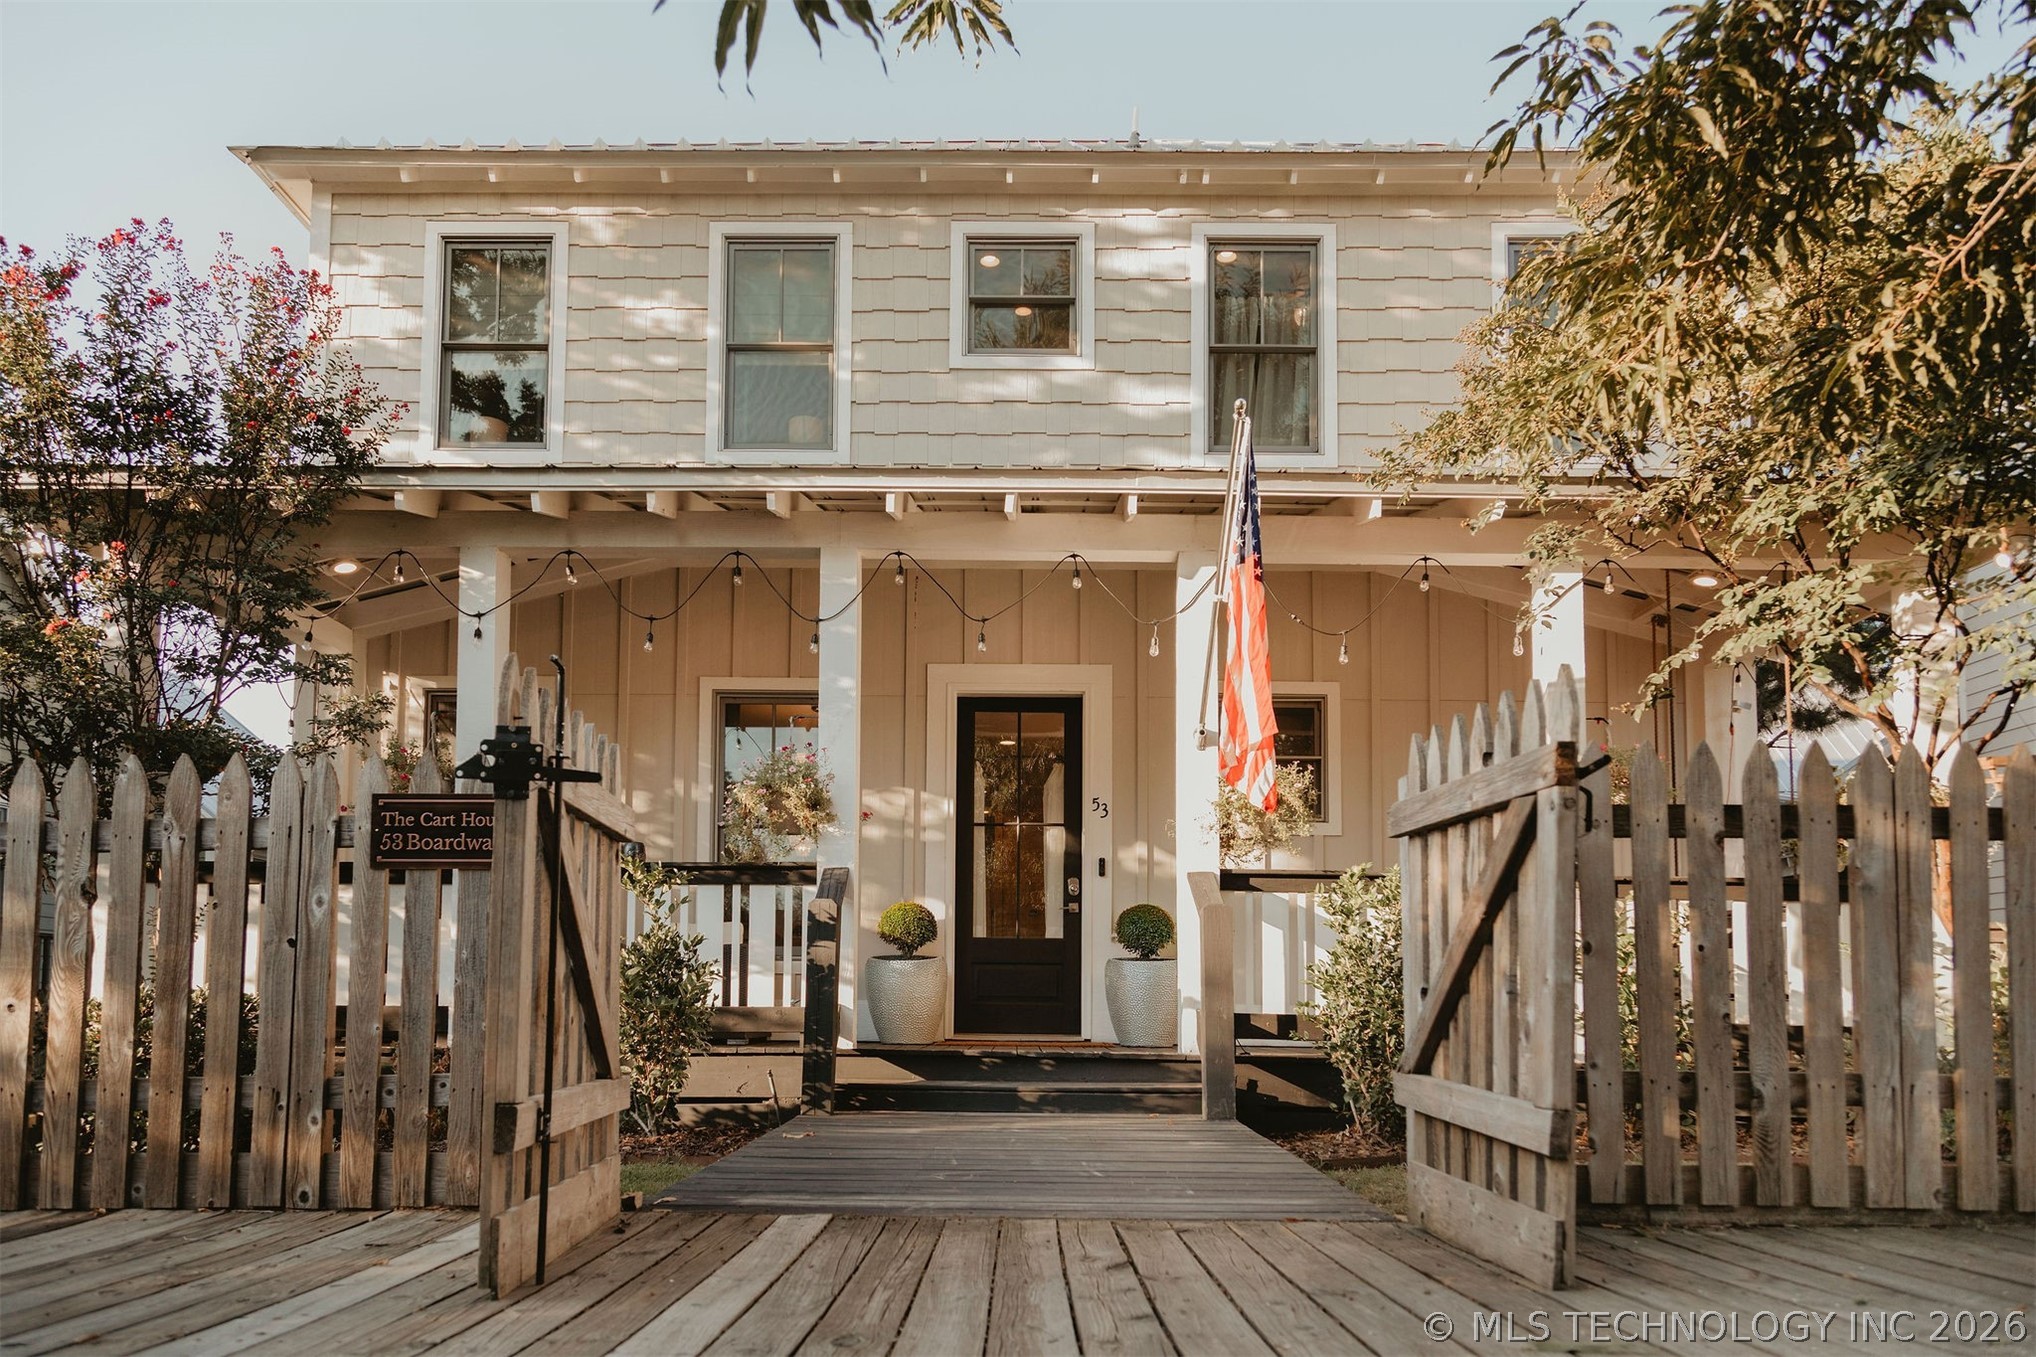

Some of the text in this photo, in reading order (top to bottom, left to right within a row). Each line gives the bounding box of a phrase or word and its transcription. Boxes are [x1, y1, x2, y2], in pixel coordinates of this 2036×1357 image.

[1092, 797, 1108, 818] 53
[381, 811, 495, 827] The Cart Hou
[380, 833, 493, 851] 53 Boardwa
